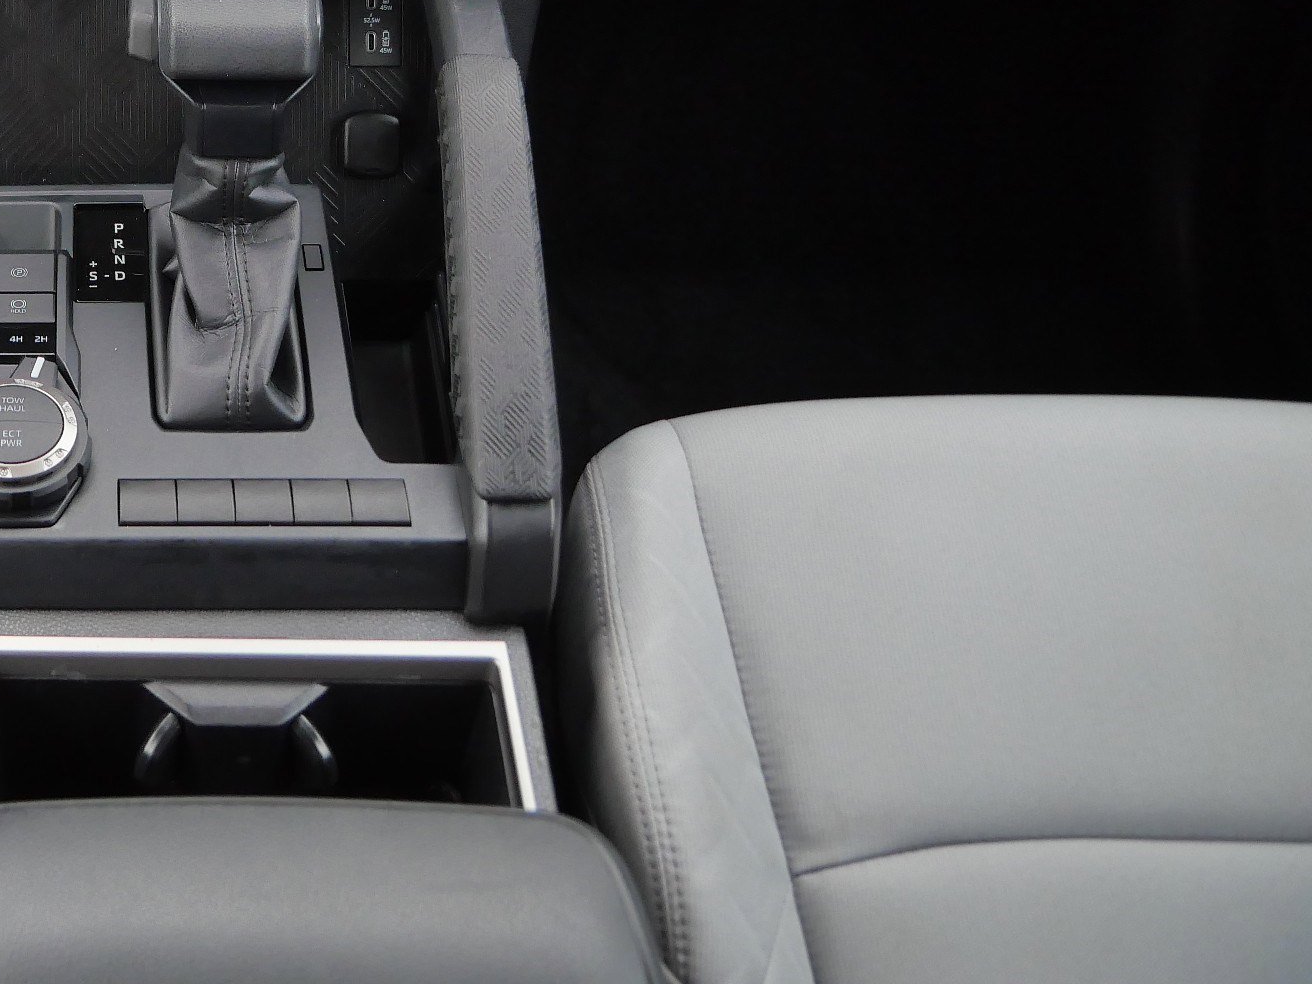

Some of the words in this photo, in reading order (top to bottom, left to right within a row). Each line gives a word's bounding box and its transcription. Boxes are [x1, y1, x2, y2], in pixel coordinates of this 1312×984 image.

[114, 223, 124, 233] P
[113, 238, 125, 249] R
[114, 255, 126, 265] N
[89, 271, 98, 281] S
[114, 271, 126, 281] D
[9, 335, 23, 343] 4H
[34, 335, 48, 343] 2H
[1, 396, 25, 404] TOW
[2, 430, 21, 438] ECT
[0, 438, 23, 447] PWR
